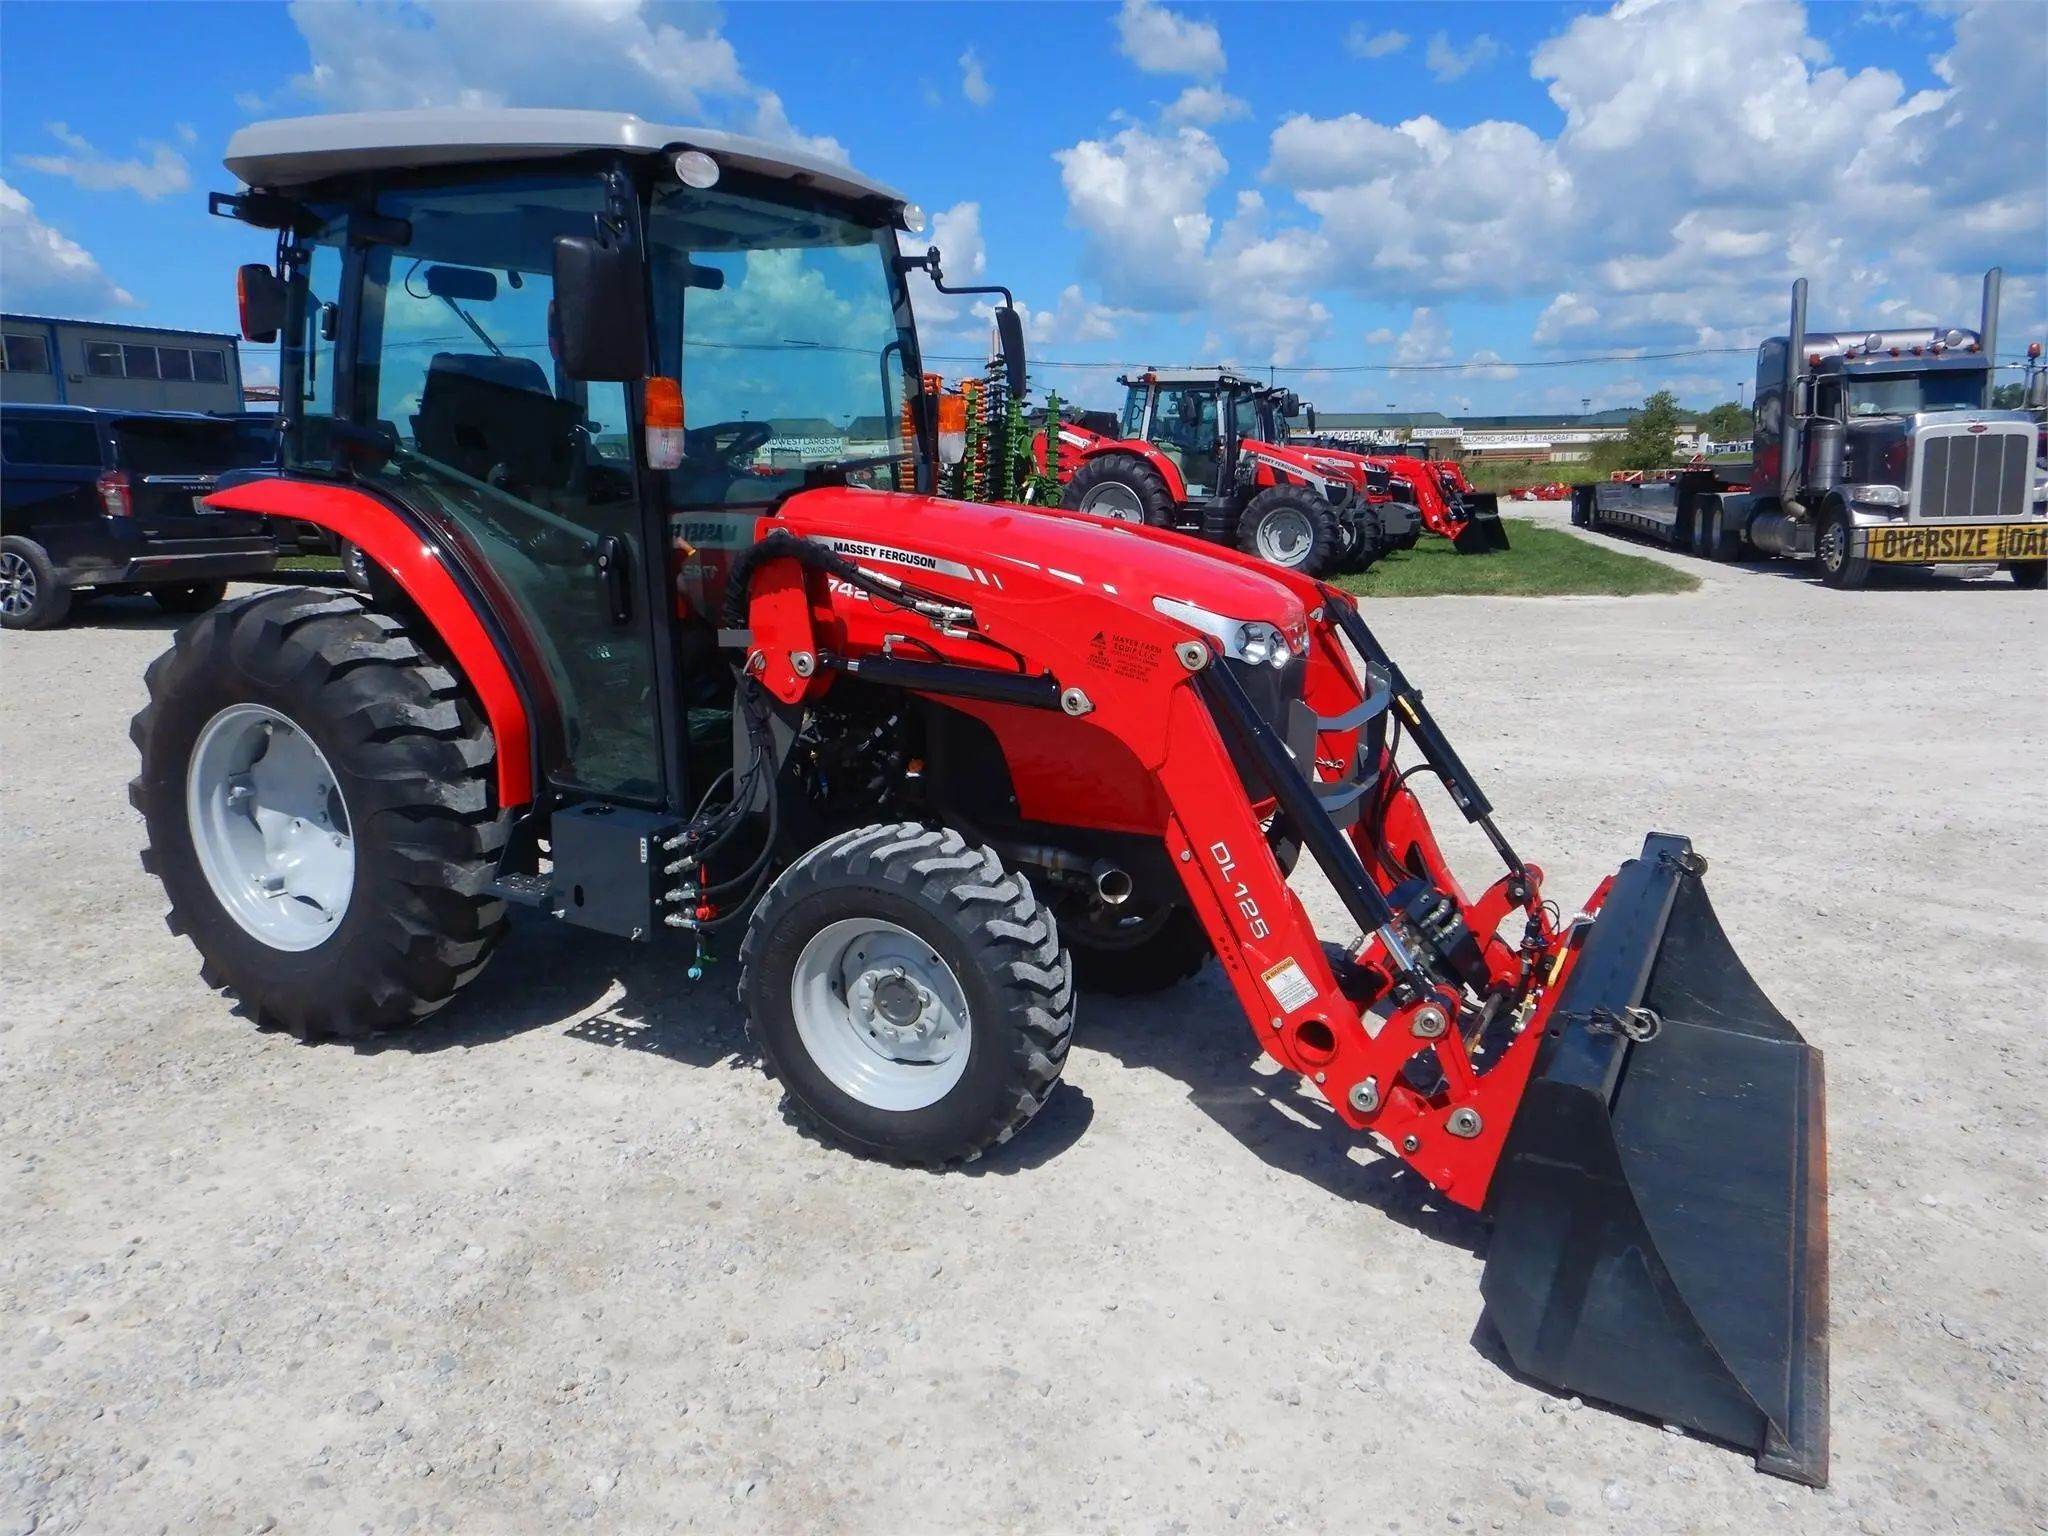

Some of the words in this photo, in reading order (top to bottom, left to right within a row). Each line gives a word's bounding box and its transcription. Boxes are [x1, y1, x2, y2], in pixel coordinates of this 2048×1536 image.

[803, 437, 839, 445] LARGEST
[1435, 428, 1463, 437] WARRANTY
[1883, 529, 1989, 558] OVERSIZE
[833, 542, 877, 557] MASSEY
[879, 549, 937, 569] FERGUSON
